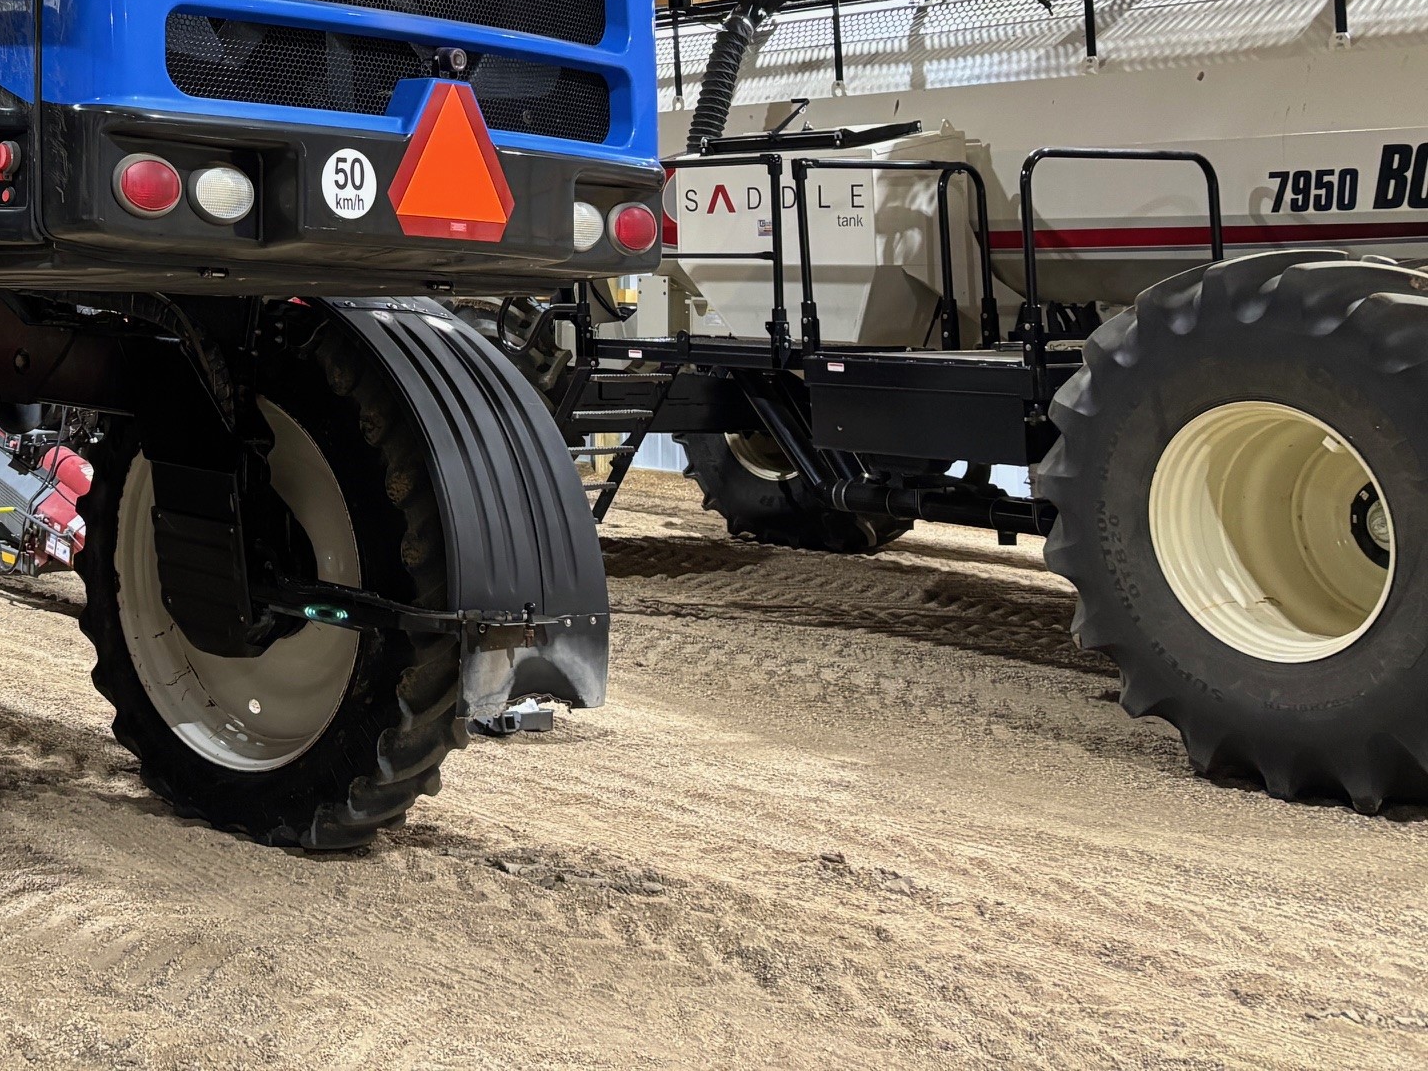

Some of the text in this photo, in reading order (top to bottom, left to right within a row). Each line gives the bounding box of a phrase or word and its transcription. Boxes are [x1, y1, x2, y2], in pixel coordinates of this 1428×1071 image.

[334, 157, 365, 190] 50
[335, 193, 365, 210] km/h
[685, 184, 865, 215] SADDLE
[1268, 168, 1359, 213] 7950
[837, 214, 864, 227] tank
